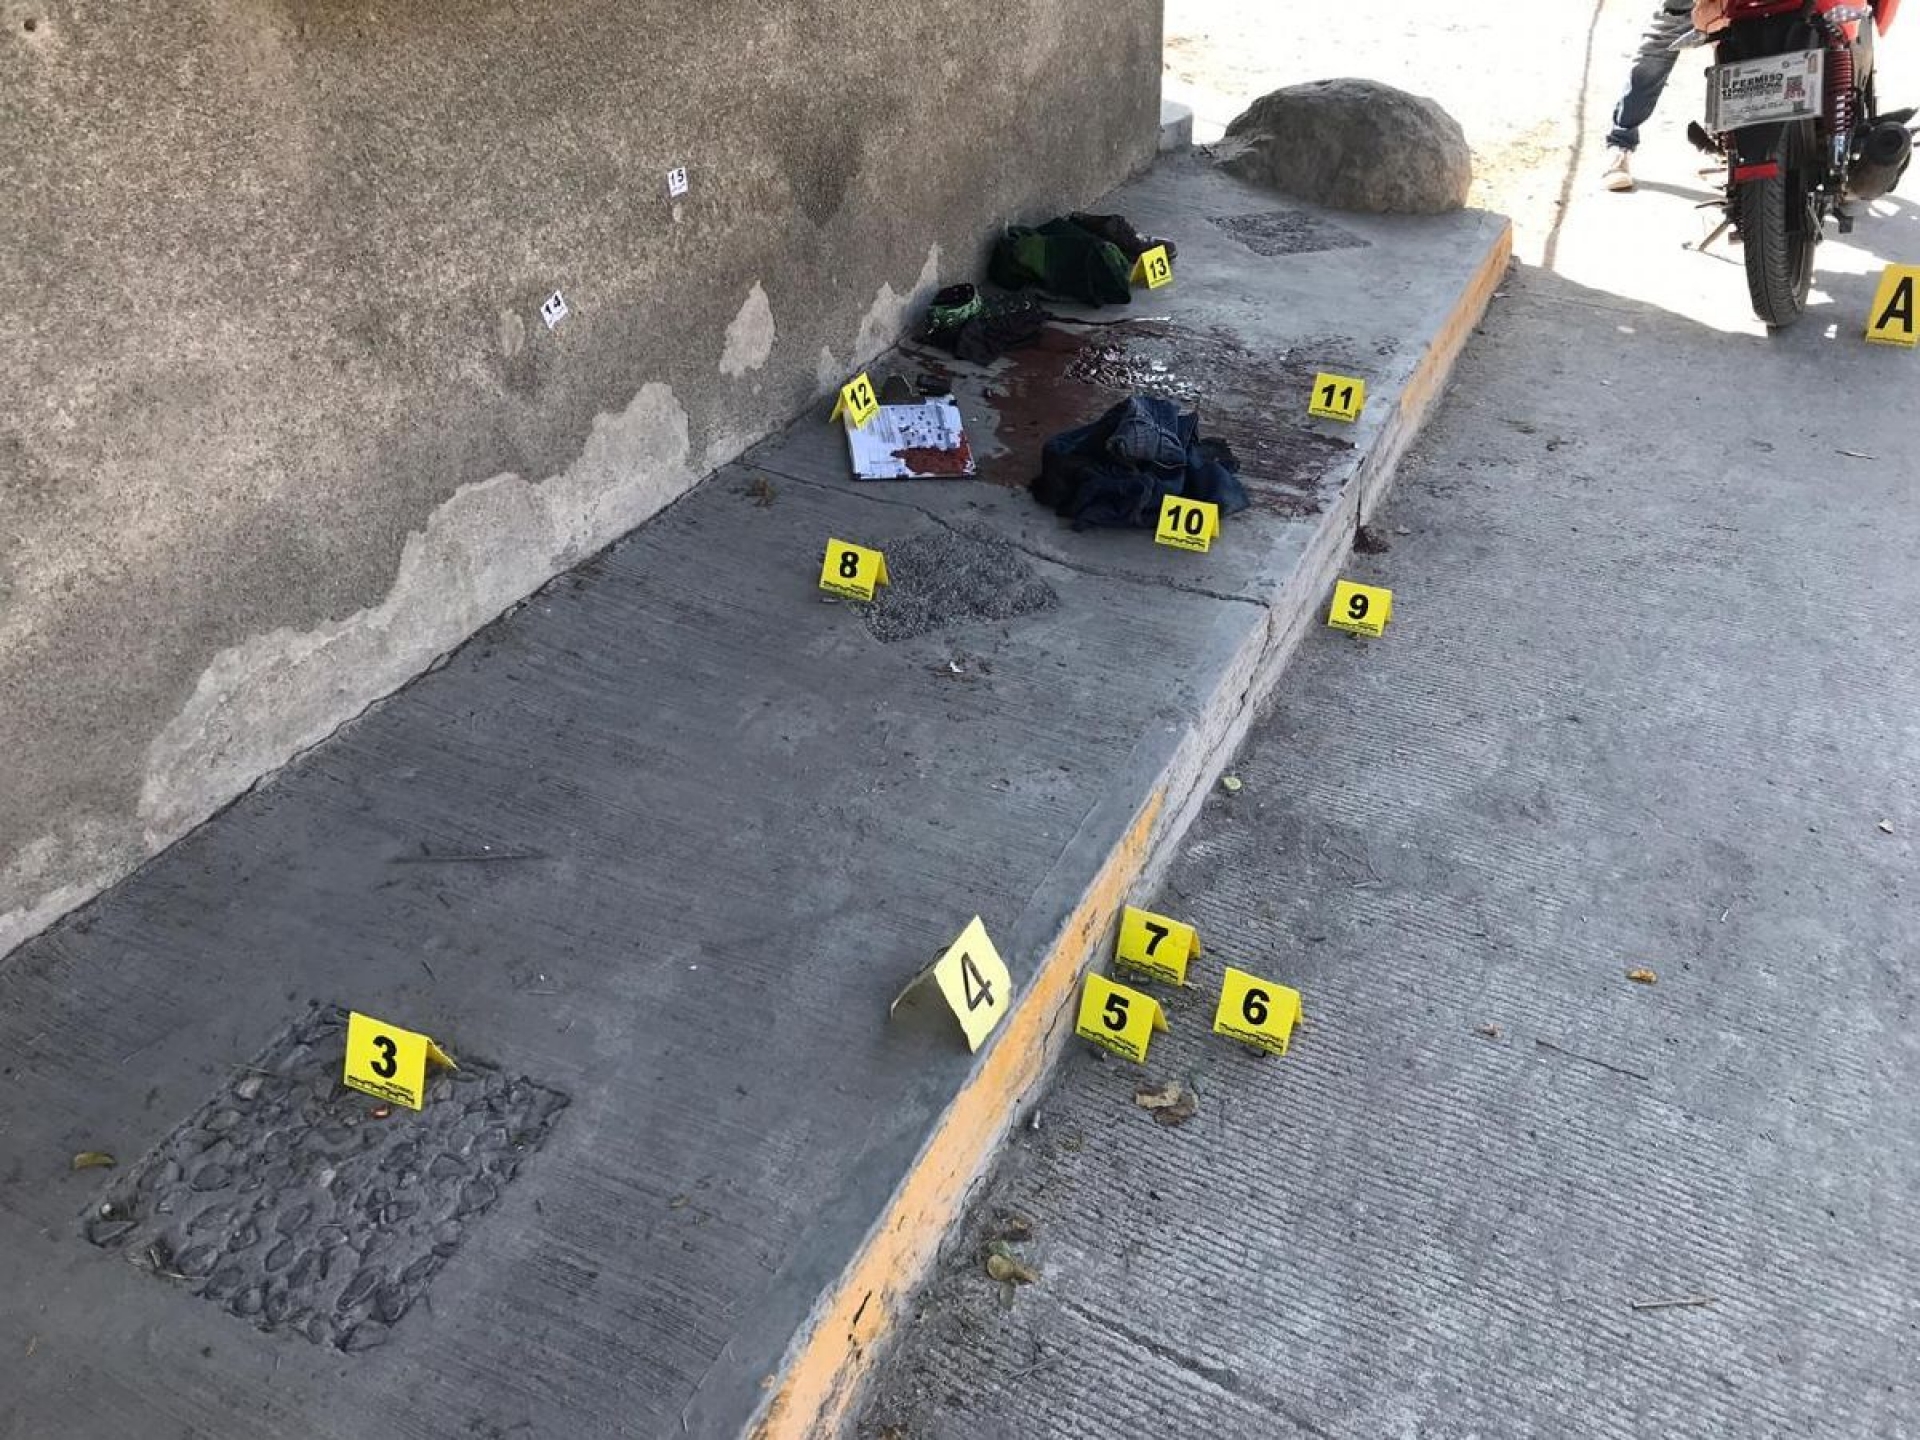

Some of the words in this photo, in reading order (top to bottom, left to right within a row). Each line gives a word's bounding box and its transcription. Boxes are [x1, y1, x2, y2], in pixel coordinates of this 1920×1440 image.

[670, 169, 684, 187] 15
[1149, 256, 1167, 279] 13
[545, 293, 561, 315] 14
[1874, 276, 1913, 334] A
[850, 382, 871, 411] 12
[1321, 383, 1353, 411] 11
[1167, 504, 1204, 535] 10
[839, 551, 860, 579] 8
[1347, 593, 1369, 620] 9
[1144, 921, 1169, 956] 7
[960, 950, 995, 1013] 4
[1101, 992, 1130, 1032] 5
[1241, 987, 1271, 1026] 6
[370, 1034, 398, 1079] 3
